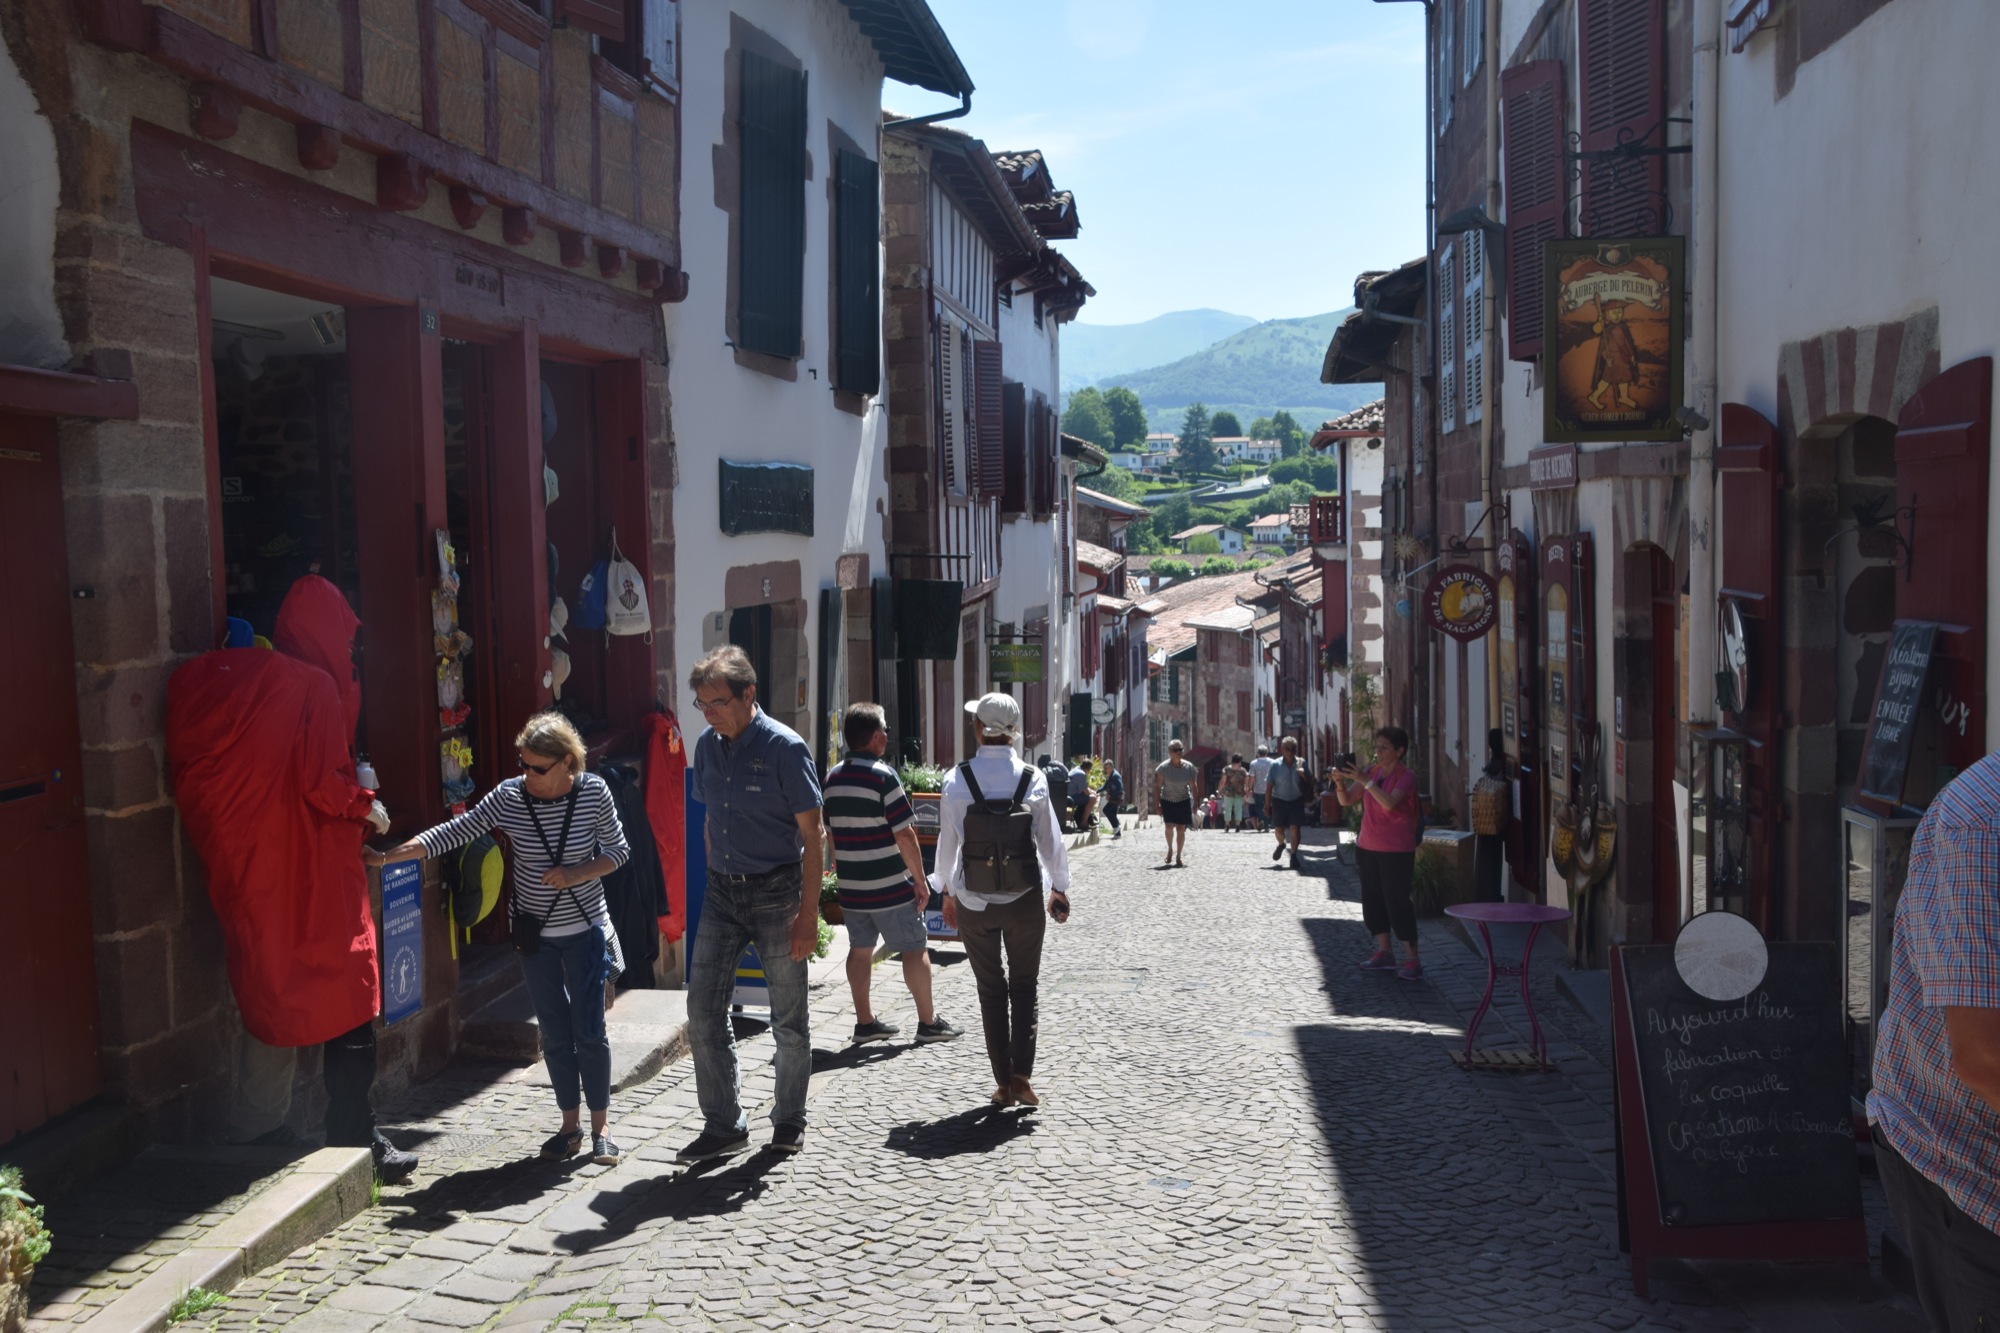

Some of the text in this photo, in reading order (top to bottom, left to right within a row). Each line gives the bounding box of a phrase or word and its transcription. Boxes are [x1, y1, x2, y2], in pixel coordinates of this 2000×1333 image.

[1574, 279, 1653, 299] AUBERGE DU PELERIN
[425, 314, 436, 330] 32
[1431, 572, 1493, 606] LA FABRIQUE
[1433, 608, 1444, 623] DE
[1443, 604, 1493, 633] MACARONS
[1875, 721, 1902, 742] LIBRE
[384, 882, 391, 892] DE
[389, 893, 415, 909] SOUVENIRS
[384, 917, 400, 930] GUIDES
[405, 908, 421, 920] LIVRES
[398, 921, 415, 933] CHEMIN
[1648, 991, 1796, 1045] Aujourd'hui
[1662, 1044, 1792, 1085] fabrication de
[1679, 1074, 1790, 1106] la coquille
